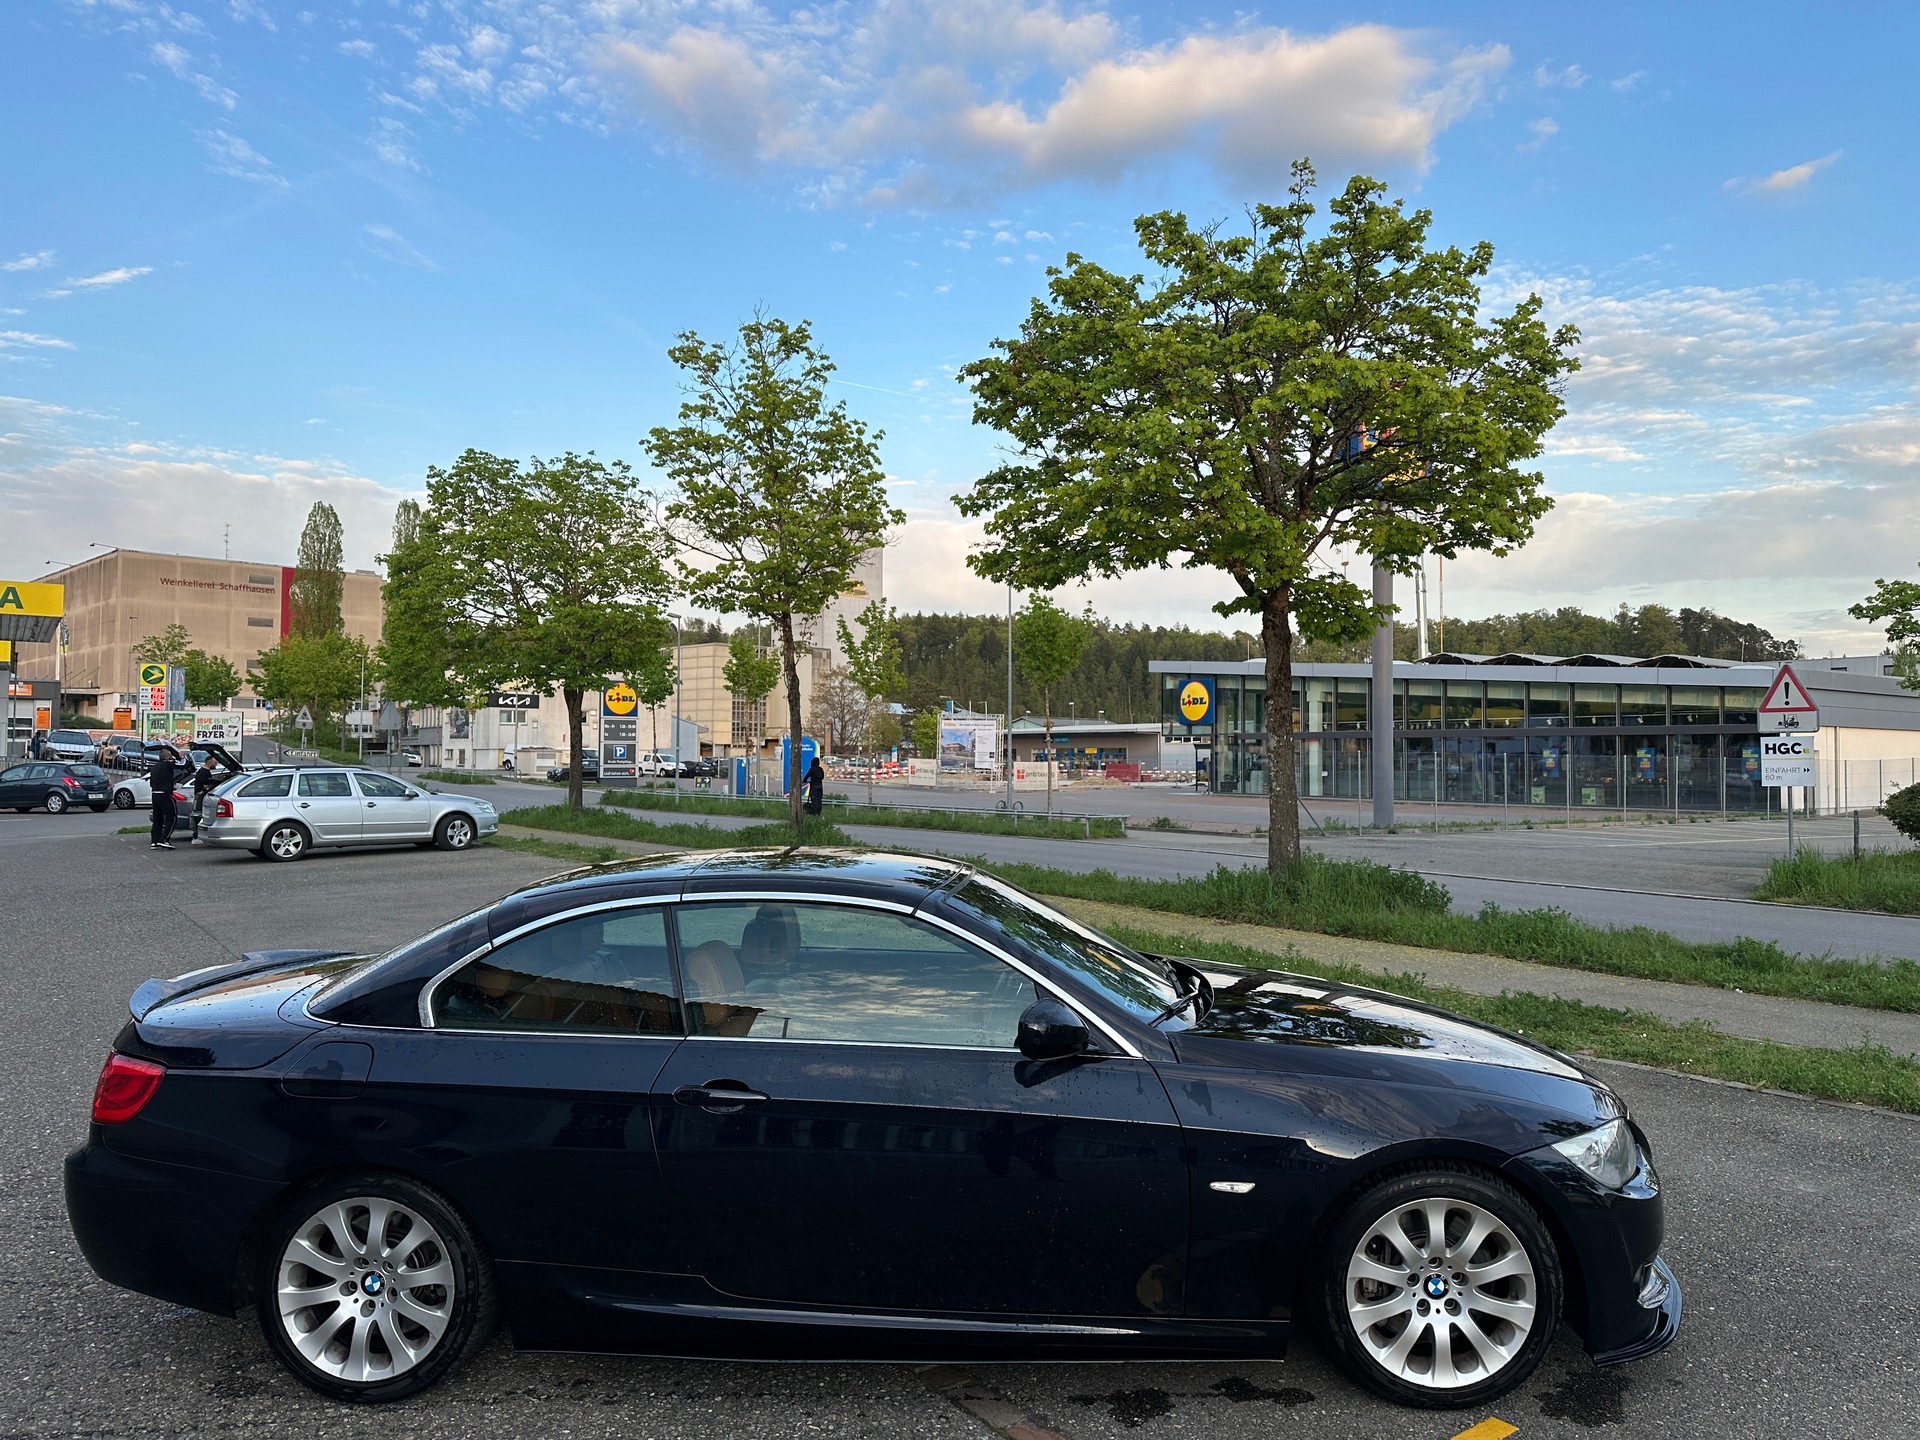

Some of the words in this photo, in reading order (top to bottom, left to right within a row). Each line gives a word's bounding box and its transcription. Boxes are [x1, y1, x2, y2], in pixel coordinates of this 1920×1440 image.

[160, 577, 215, 590] Weinkellerei
[219, 582, 276, 595] Schaffhausen
[0, 586, 24, 609] A
[196, 730, 225, 739] FRYER
[615, 746, 625, 757] P
[1764, 742, 1803, 755] HGC
